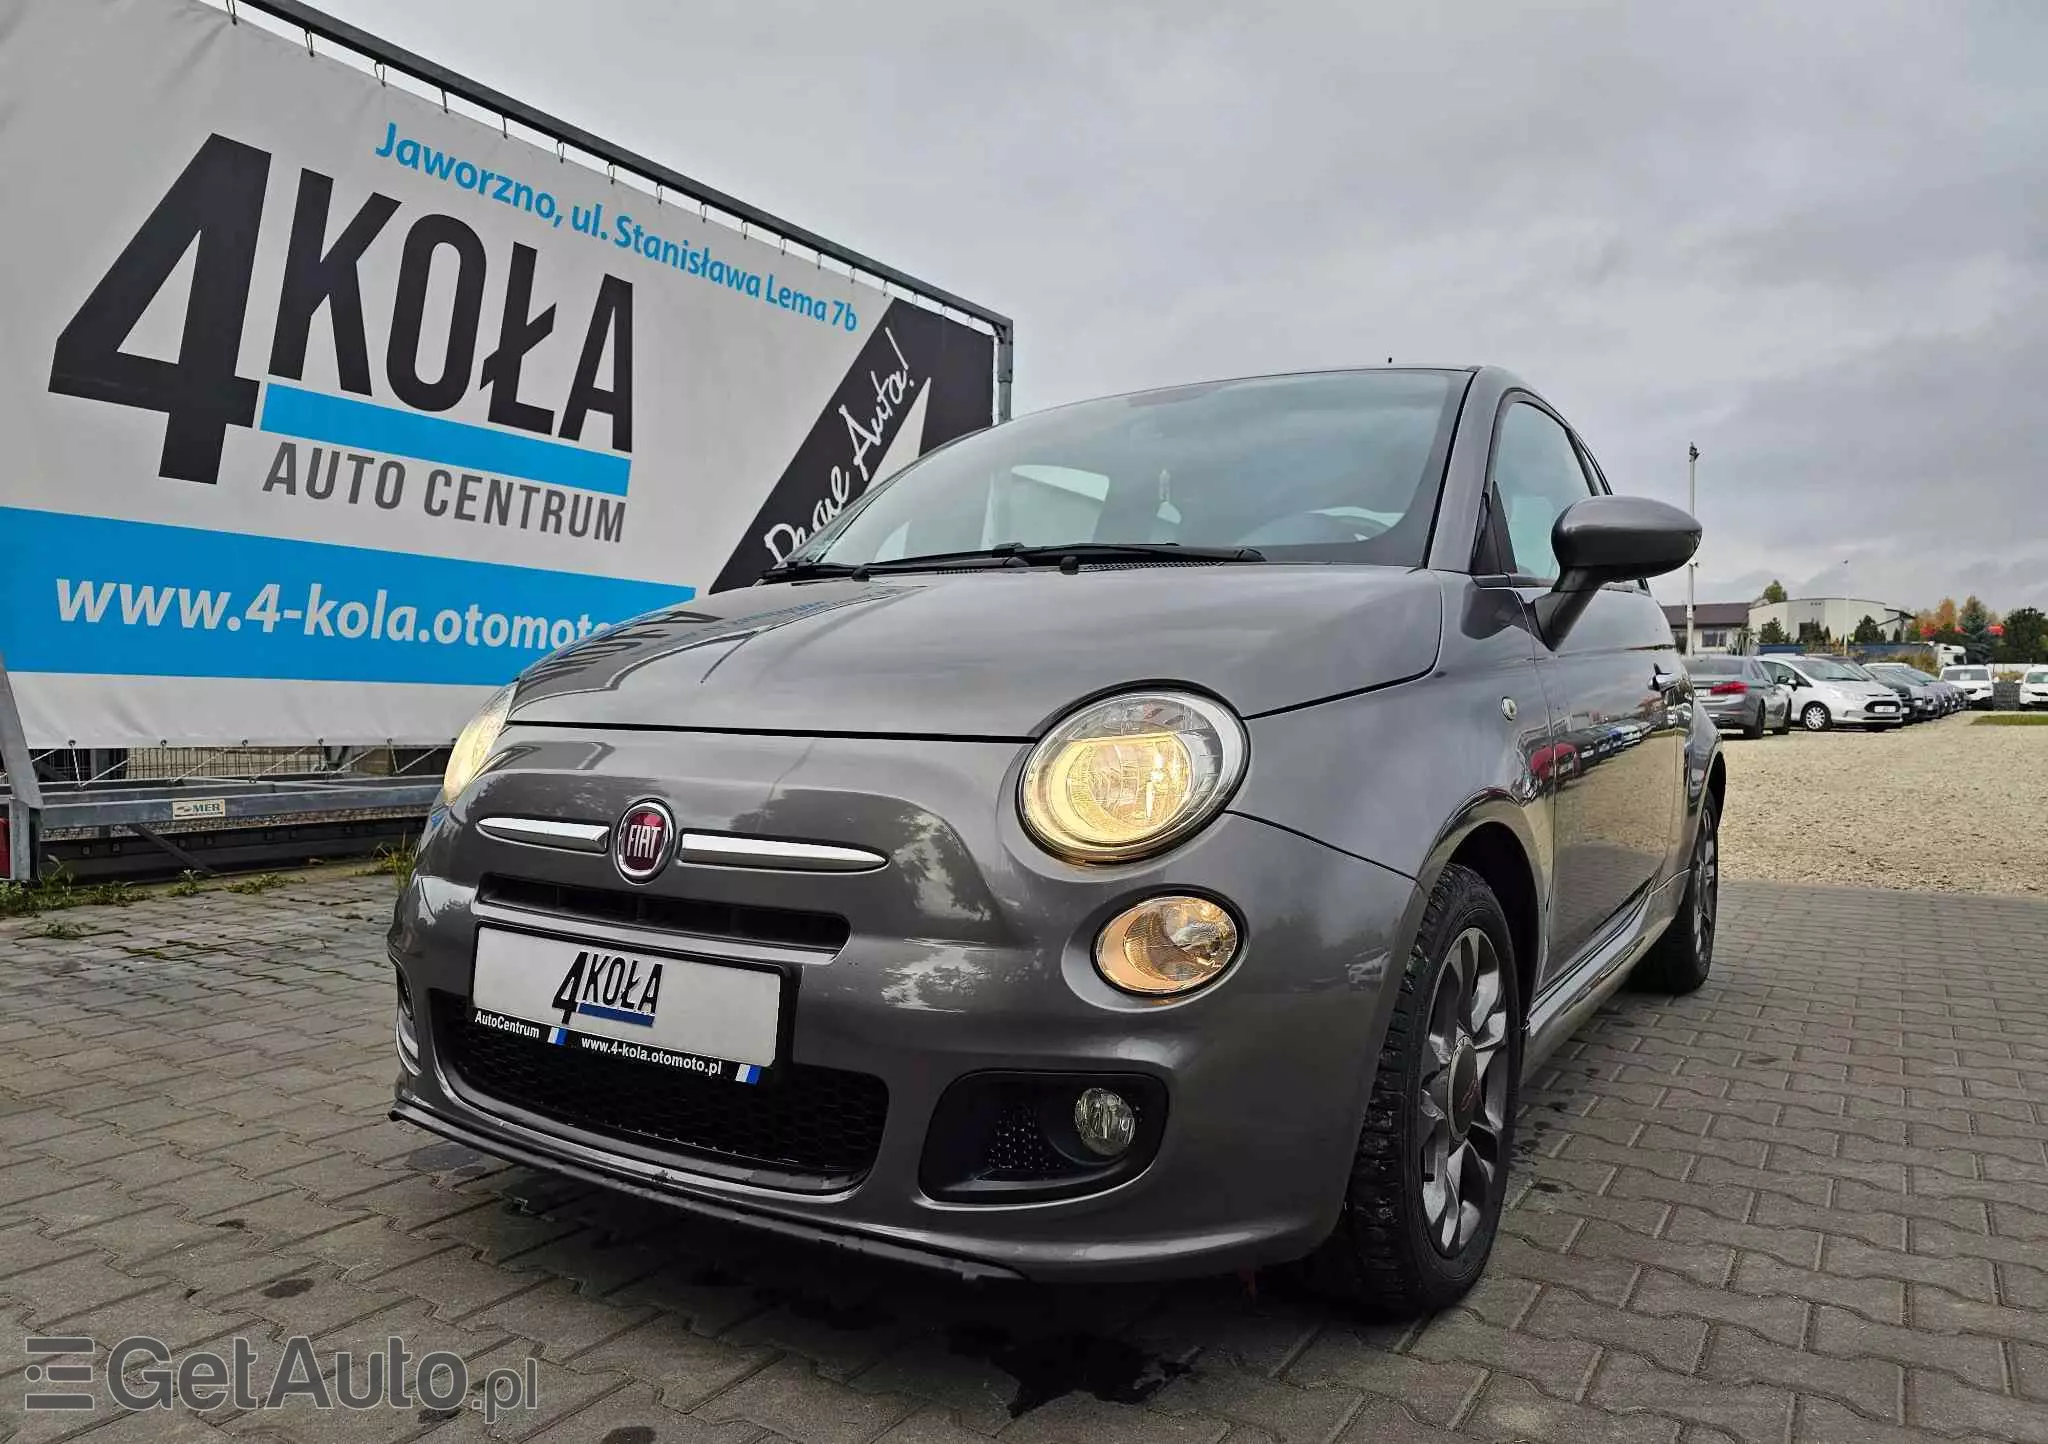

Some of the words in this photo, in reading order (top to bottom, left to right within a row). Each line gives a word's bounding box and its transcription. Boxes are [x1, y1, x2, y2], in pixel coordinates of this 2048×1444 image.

[375, 122, 563, 228] Jaworzno,
[572, 204, 608, 241] ul.
[614, 214, 760, 298] Stanisława
[766, 273, 827, 322] Lema
[833, 299, 858, 332] 7b
[262, 441, 406, 510] AUTO
[424, 475, 626, 544] CENTRUM
[55, 577, 615, 651] www.4-kola.otomot
[627, 823, 662, 859] FIAT
[474, 1011, 540, 1040] AutoCentrum
[581, 1036, 722, 1077] www.4-kola.otomoto.pl
